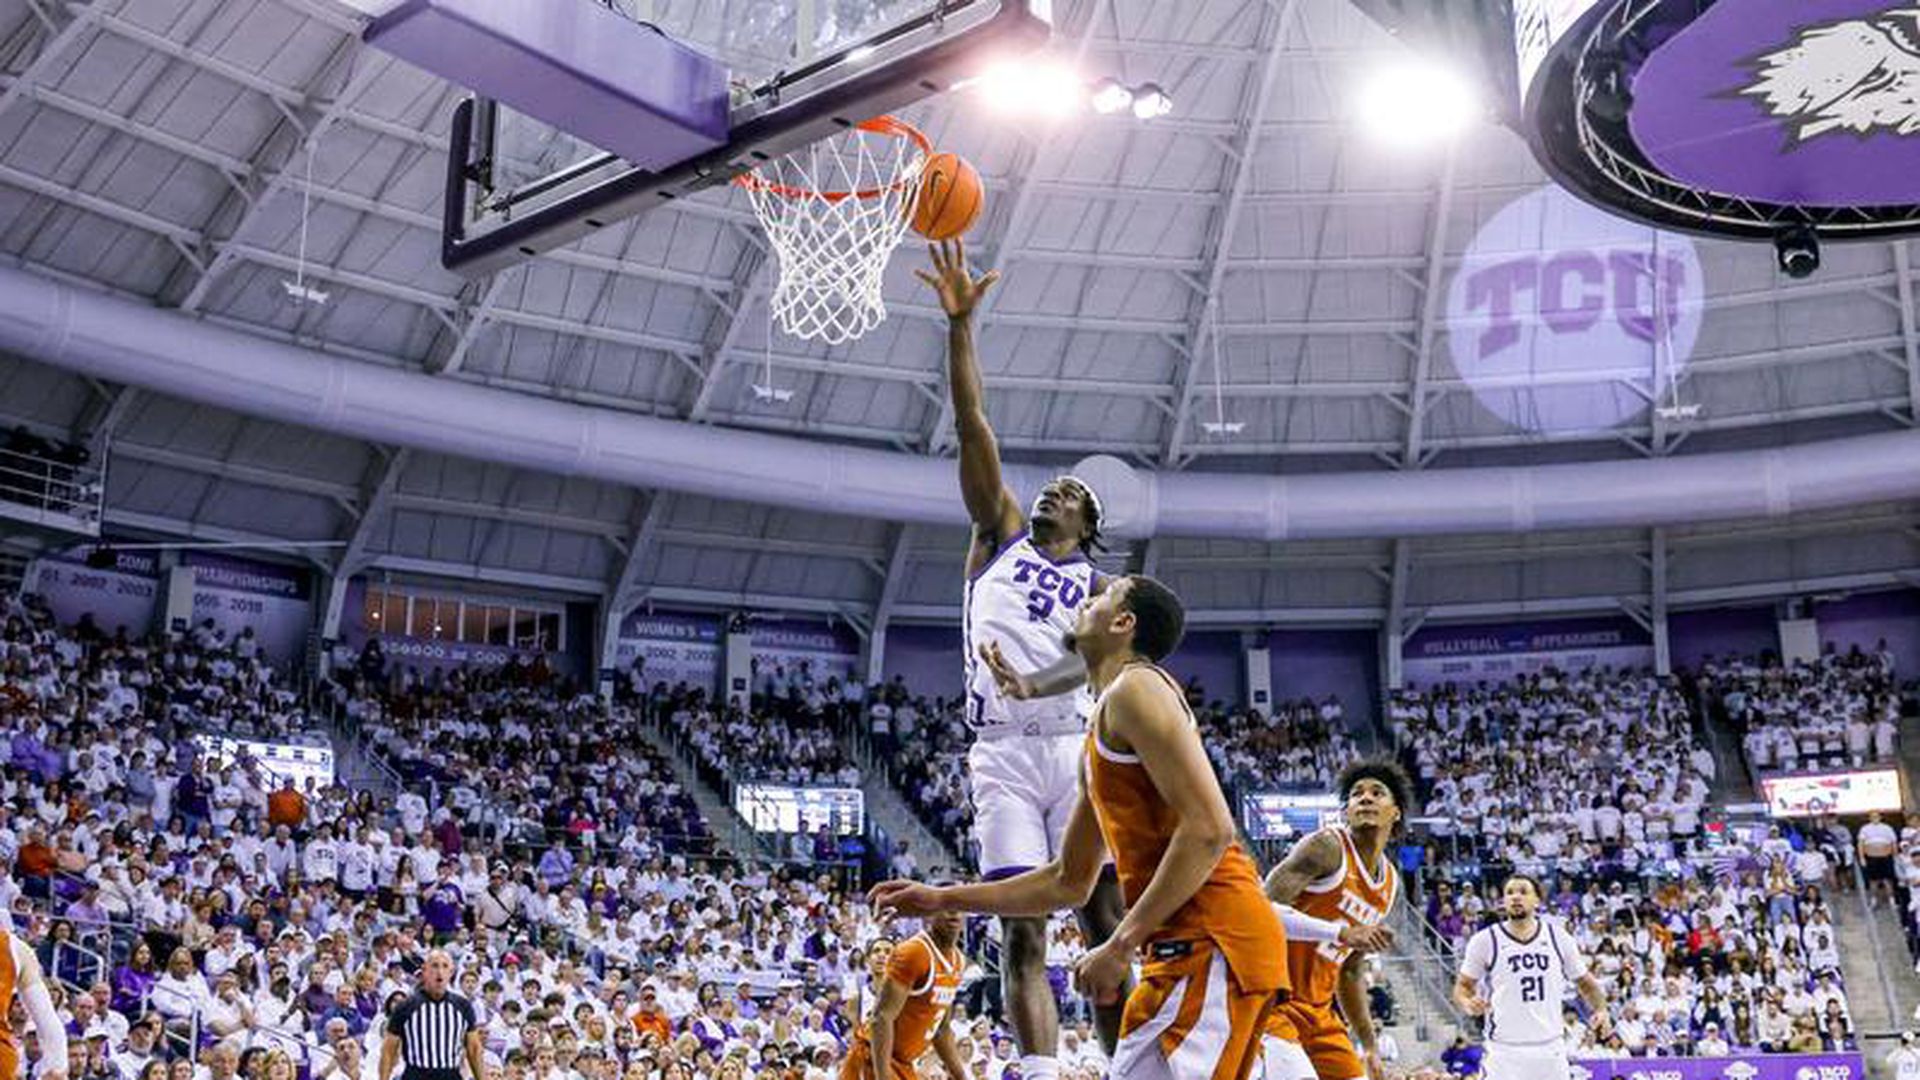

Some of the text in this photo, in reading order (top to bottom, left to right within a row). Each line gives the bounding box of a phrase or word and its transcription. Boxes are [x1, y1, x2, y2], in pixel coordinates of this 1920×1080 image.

[1464, 250, 1687, 361] TCU
[1013, 558, 1084, 609] TCU
[1026, 590, 1055, 623] 2
[1508, 953, 1550, 974] TCU
[1520, 976, 1545, 1002] 21
